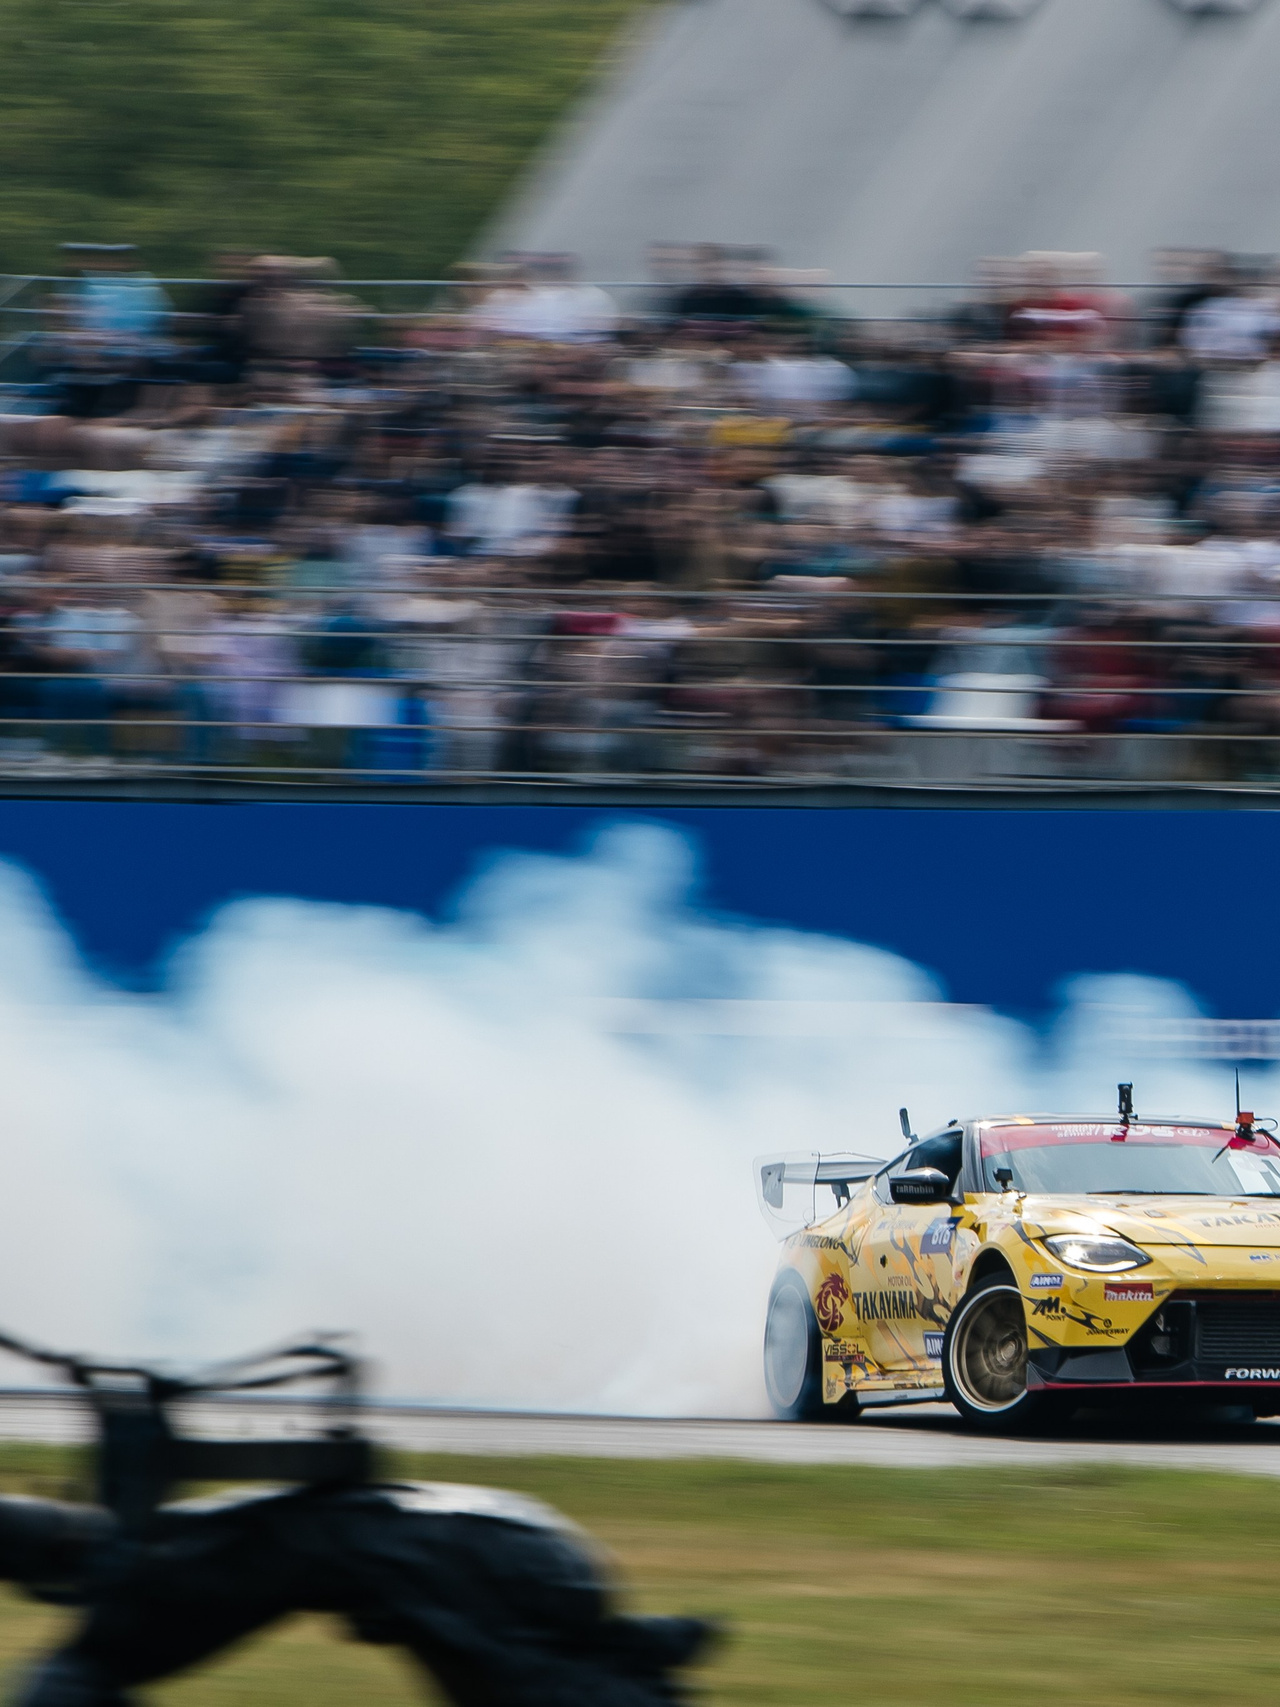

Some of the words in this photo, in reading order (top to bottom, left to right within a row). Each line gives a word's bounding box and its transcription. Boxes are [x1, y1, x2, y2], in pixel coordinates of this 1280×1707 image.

[888, 1276, 904, 1287] MOTOR
[1104, 1289, 1154, 1301] makita
[853, 1291, 917, 1320] TAKAYAMA
